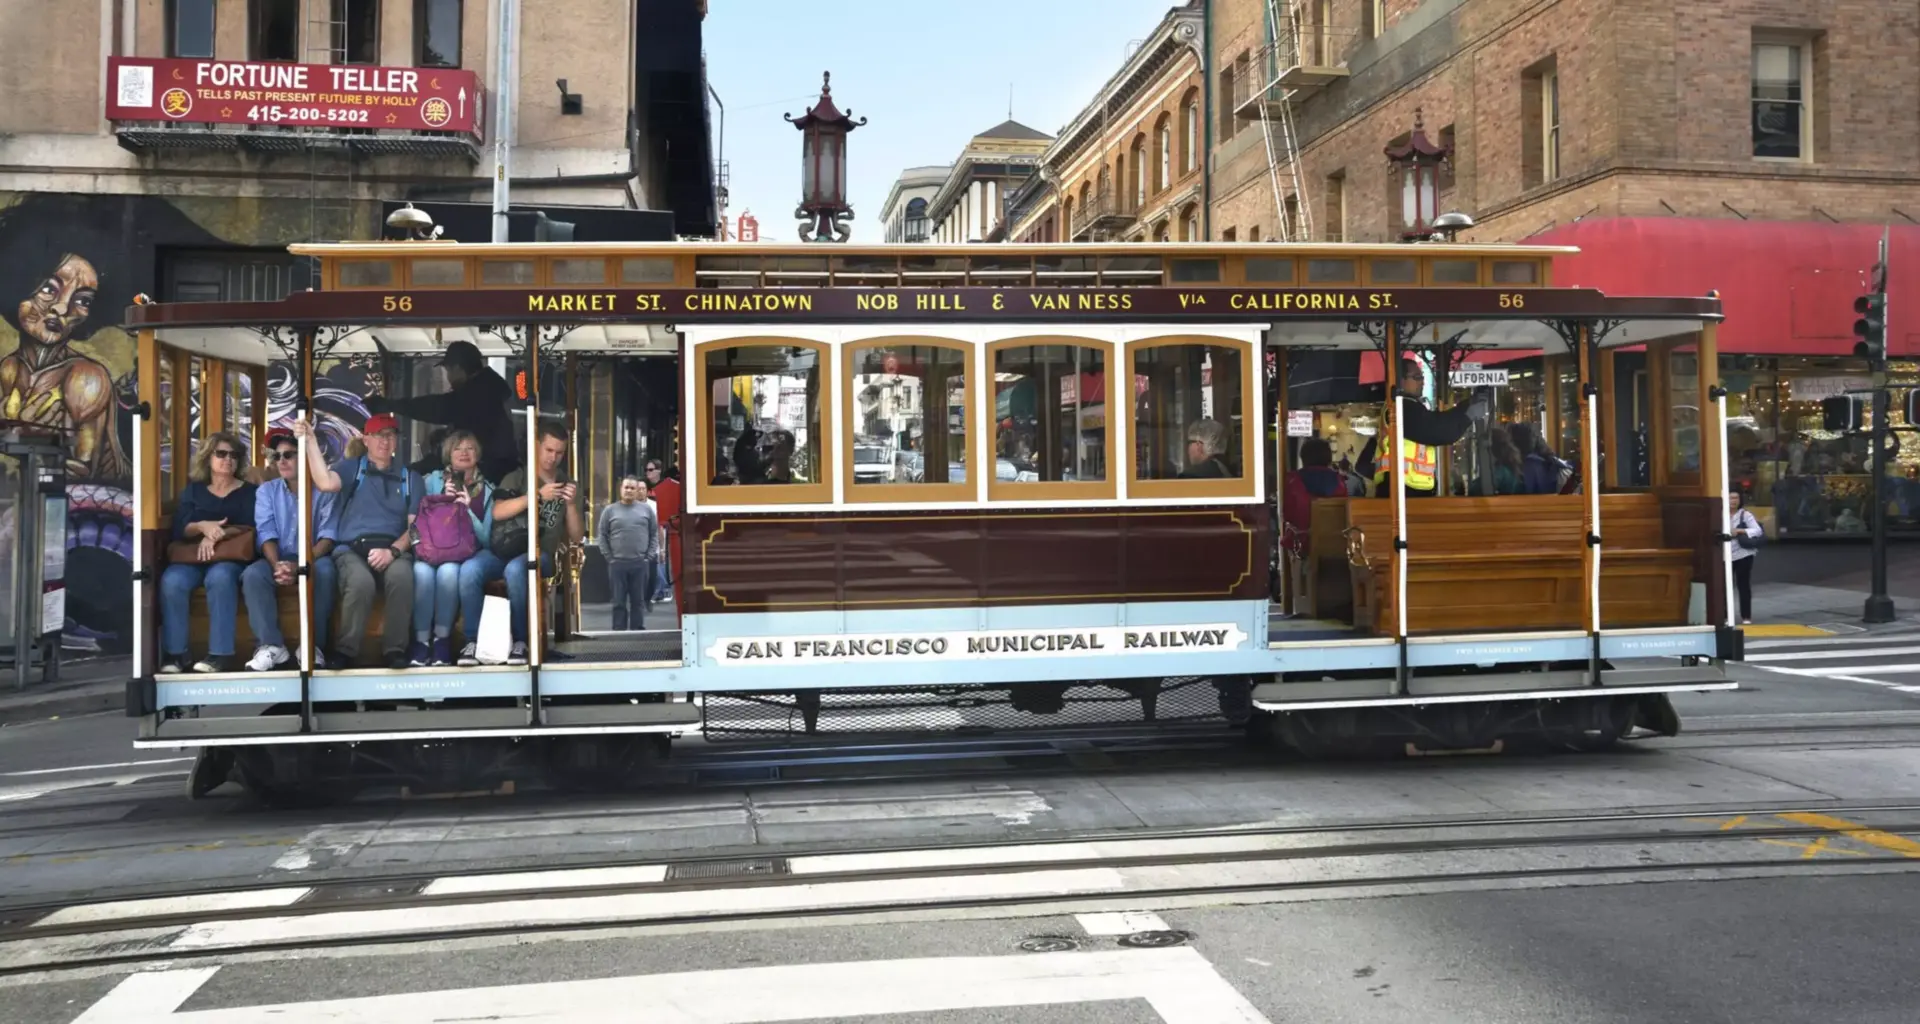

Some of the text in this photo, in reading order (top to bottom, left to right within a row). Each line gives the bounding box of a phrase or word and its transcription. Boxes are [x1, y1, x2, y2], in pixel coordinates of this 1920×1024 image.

[197, 63, 418, 93] FORTUNE TELLER
[168, 91, 187, 113] 愛
[197, 89, 418, 107] TELLS PAST PRESENT FUTURE BY HOLLY
[247, 105, 369, 122] 415-200-5202
[427, 101, 446, 122] 樂
[383, 296, 412, 311] 56
[528, 295, 616, 311] MARKET
[636, 295, 666, 311] ST.
[685, 295, 812, 311] CHINATOWN
[857, 294, 898, 310] NOB
[917, 295, 965, 310] HILL
[992, 295, 1004, 310] &
[1030, 295, 1070, 309] VAN
[1079, 294, 1132, 309] NESS
[1230, 294, 1360, 309] CALIFORNIA
[1369, 294, 1398, 309] ST.
[1499, 295, 1525, 309] 56
[1453, 372, 1506, 384] LIFORNIA
[726, 629, 1228, 659] SAN FRANCISCO MUNICIPAL RAILWAY
